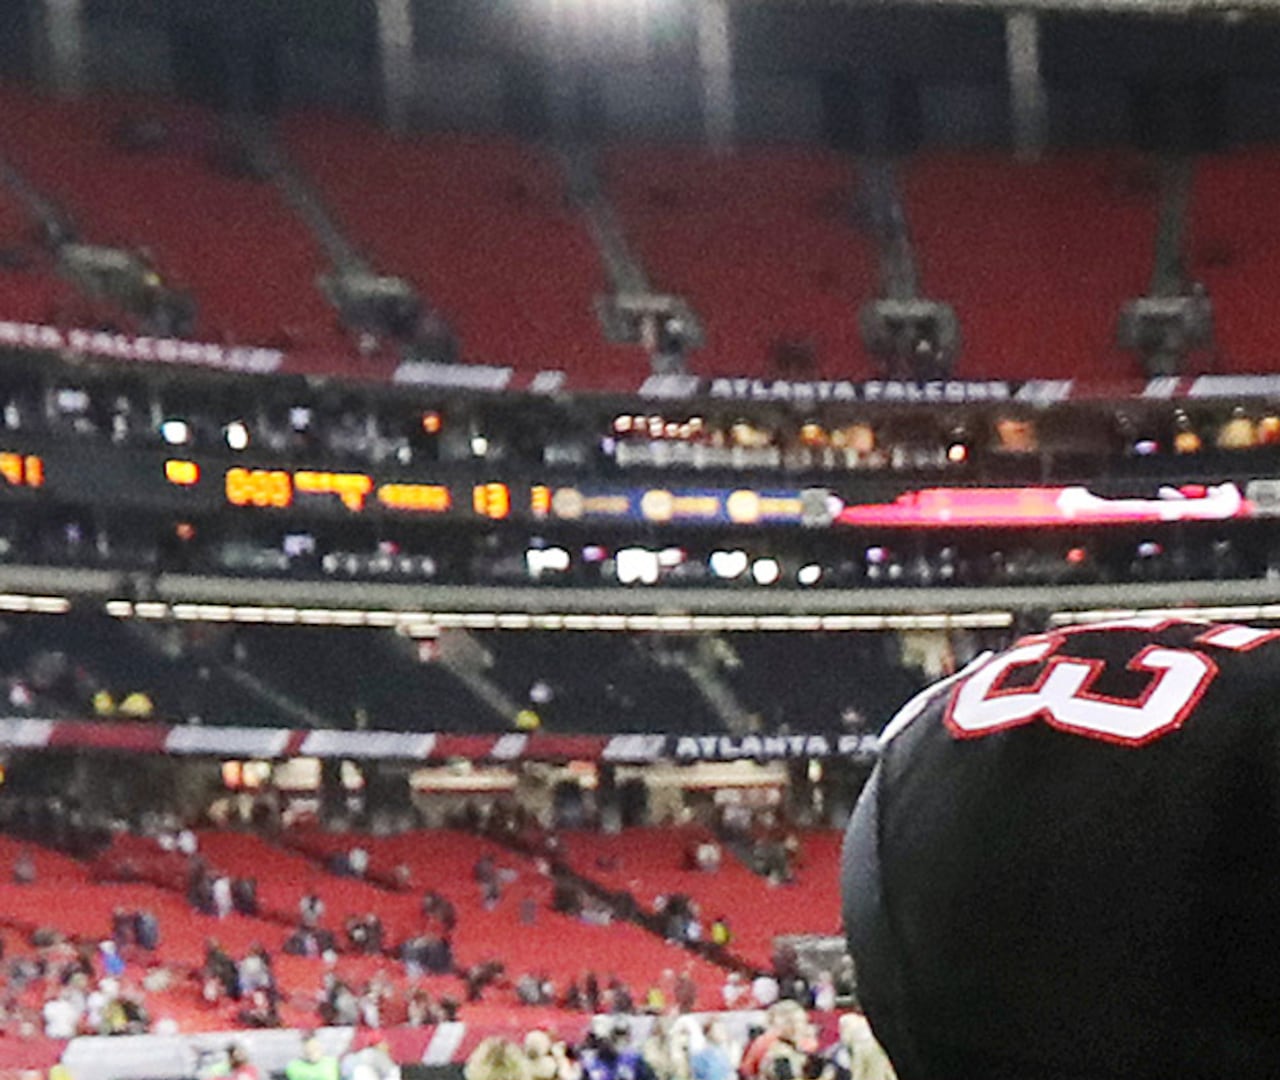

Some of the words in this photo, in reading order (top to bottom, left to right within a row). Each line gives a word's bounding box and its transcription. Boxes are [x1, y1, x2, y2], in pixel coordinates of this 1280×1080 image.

[709, 377, 855, 399] ATLANTA
[862, 380, 1010, 401] FALCONS
[676, 735, 829, 757] ATLANTA
